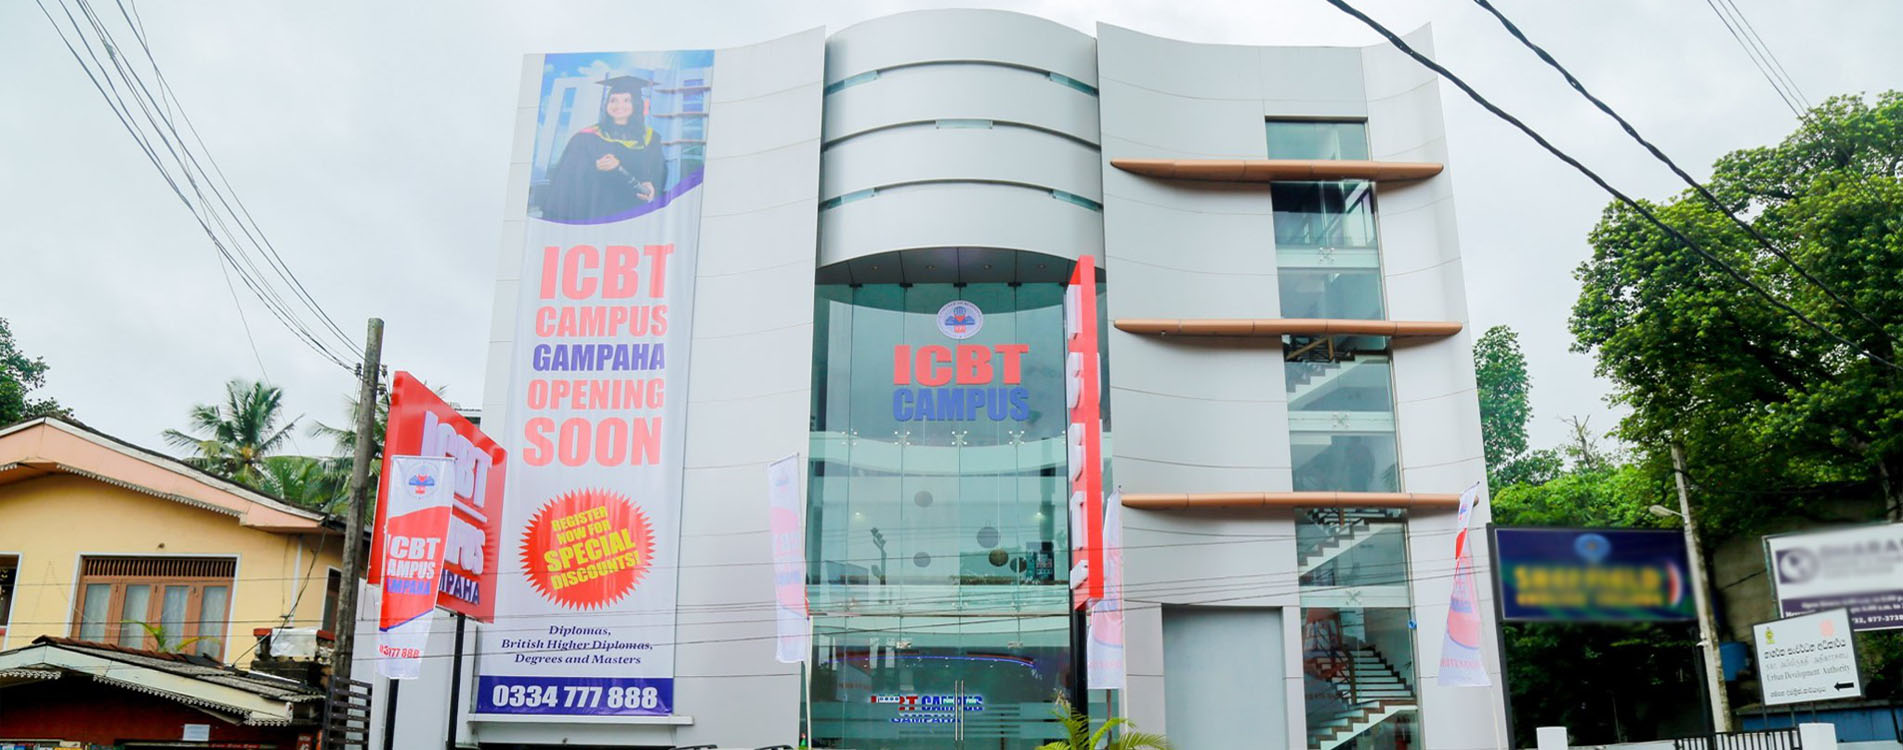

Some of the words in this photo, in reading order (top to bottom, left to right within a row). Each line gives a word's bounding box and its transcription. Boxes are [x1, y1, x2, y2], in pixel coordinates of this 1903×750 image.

[539, 243, 675, 300] ICBT
[535, 304, 668, 337] CAMPUS
[532, 343, 665, 371] GAMPAHA
[893, 344, 1029, 387] ICBT
[527, 378, 665, 410] OPENING
[893, 387, 1029, 422] CAMPUS
[522, 416, 663, 467] SOON
[552, 506, 609, 531] REGISTER
[556, 528, 587, 545] NOW
[588, 520, 612, 537] FOR
[544, 528, 636, 571] SPECIAL
[386, 559, 436, 579] AMPUS
[551, 551, 641, 590] DISCOUNTS!
[439, 568, 480, 605] MPAHA
[501, 638, 544, 650] British
[546, 639, 590, 652] Higher
[592, 641, 653, 652] Diplomas,
[548, 625, 612, 637] Diplomas,
[514, 653, 563, 666] Degrees
[565, 656, 590, 665] and
[591, 657, 641, 665] Masters
[1784, 666, 1820, 679] Development
[1822, 663, 1850, 675] Authority
[492, 685, 558, 708] 0334
[563, 686, 604, 708] 777
[607, 687, 658, 709] 888
